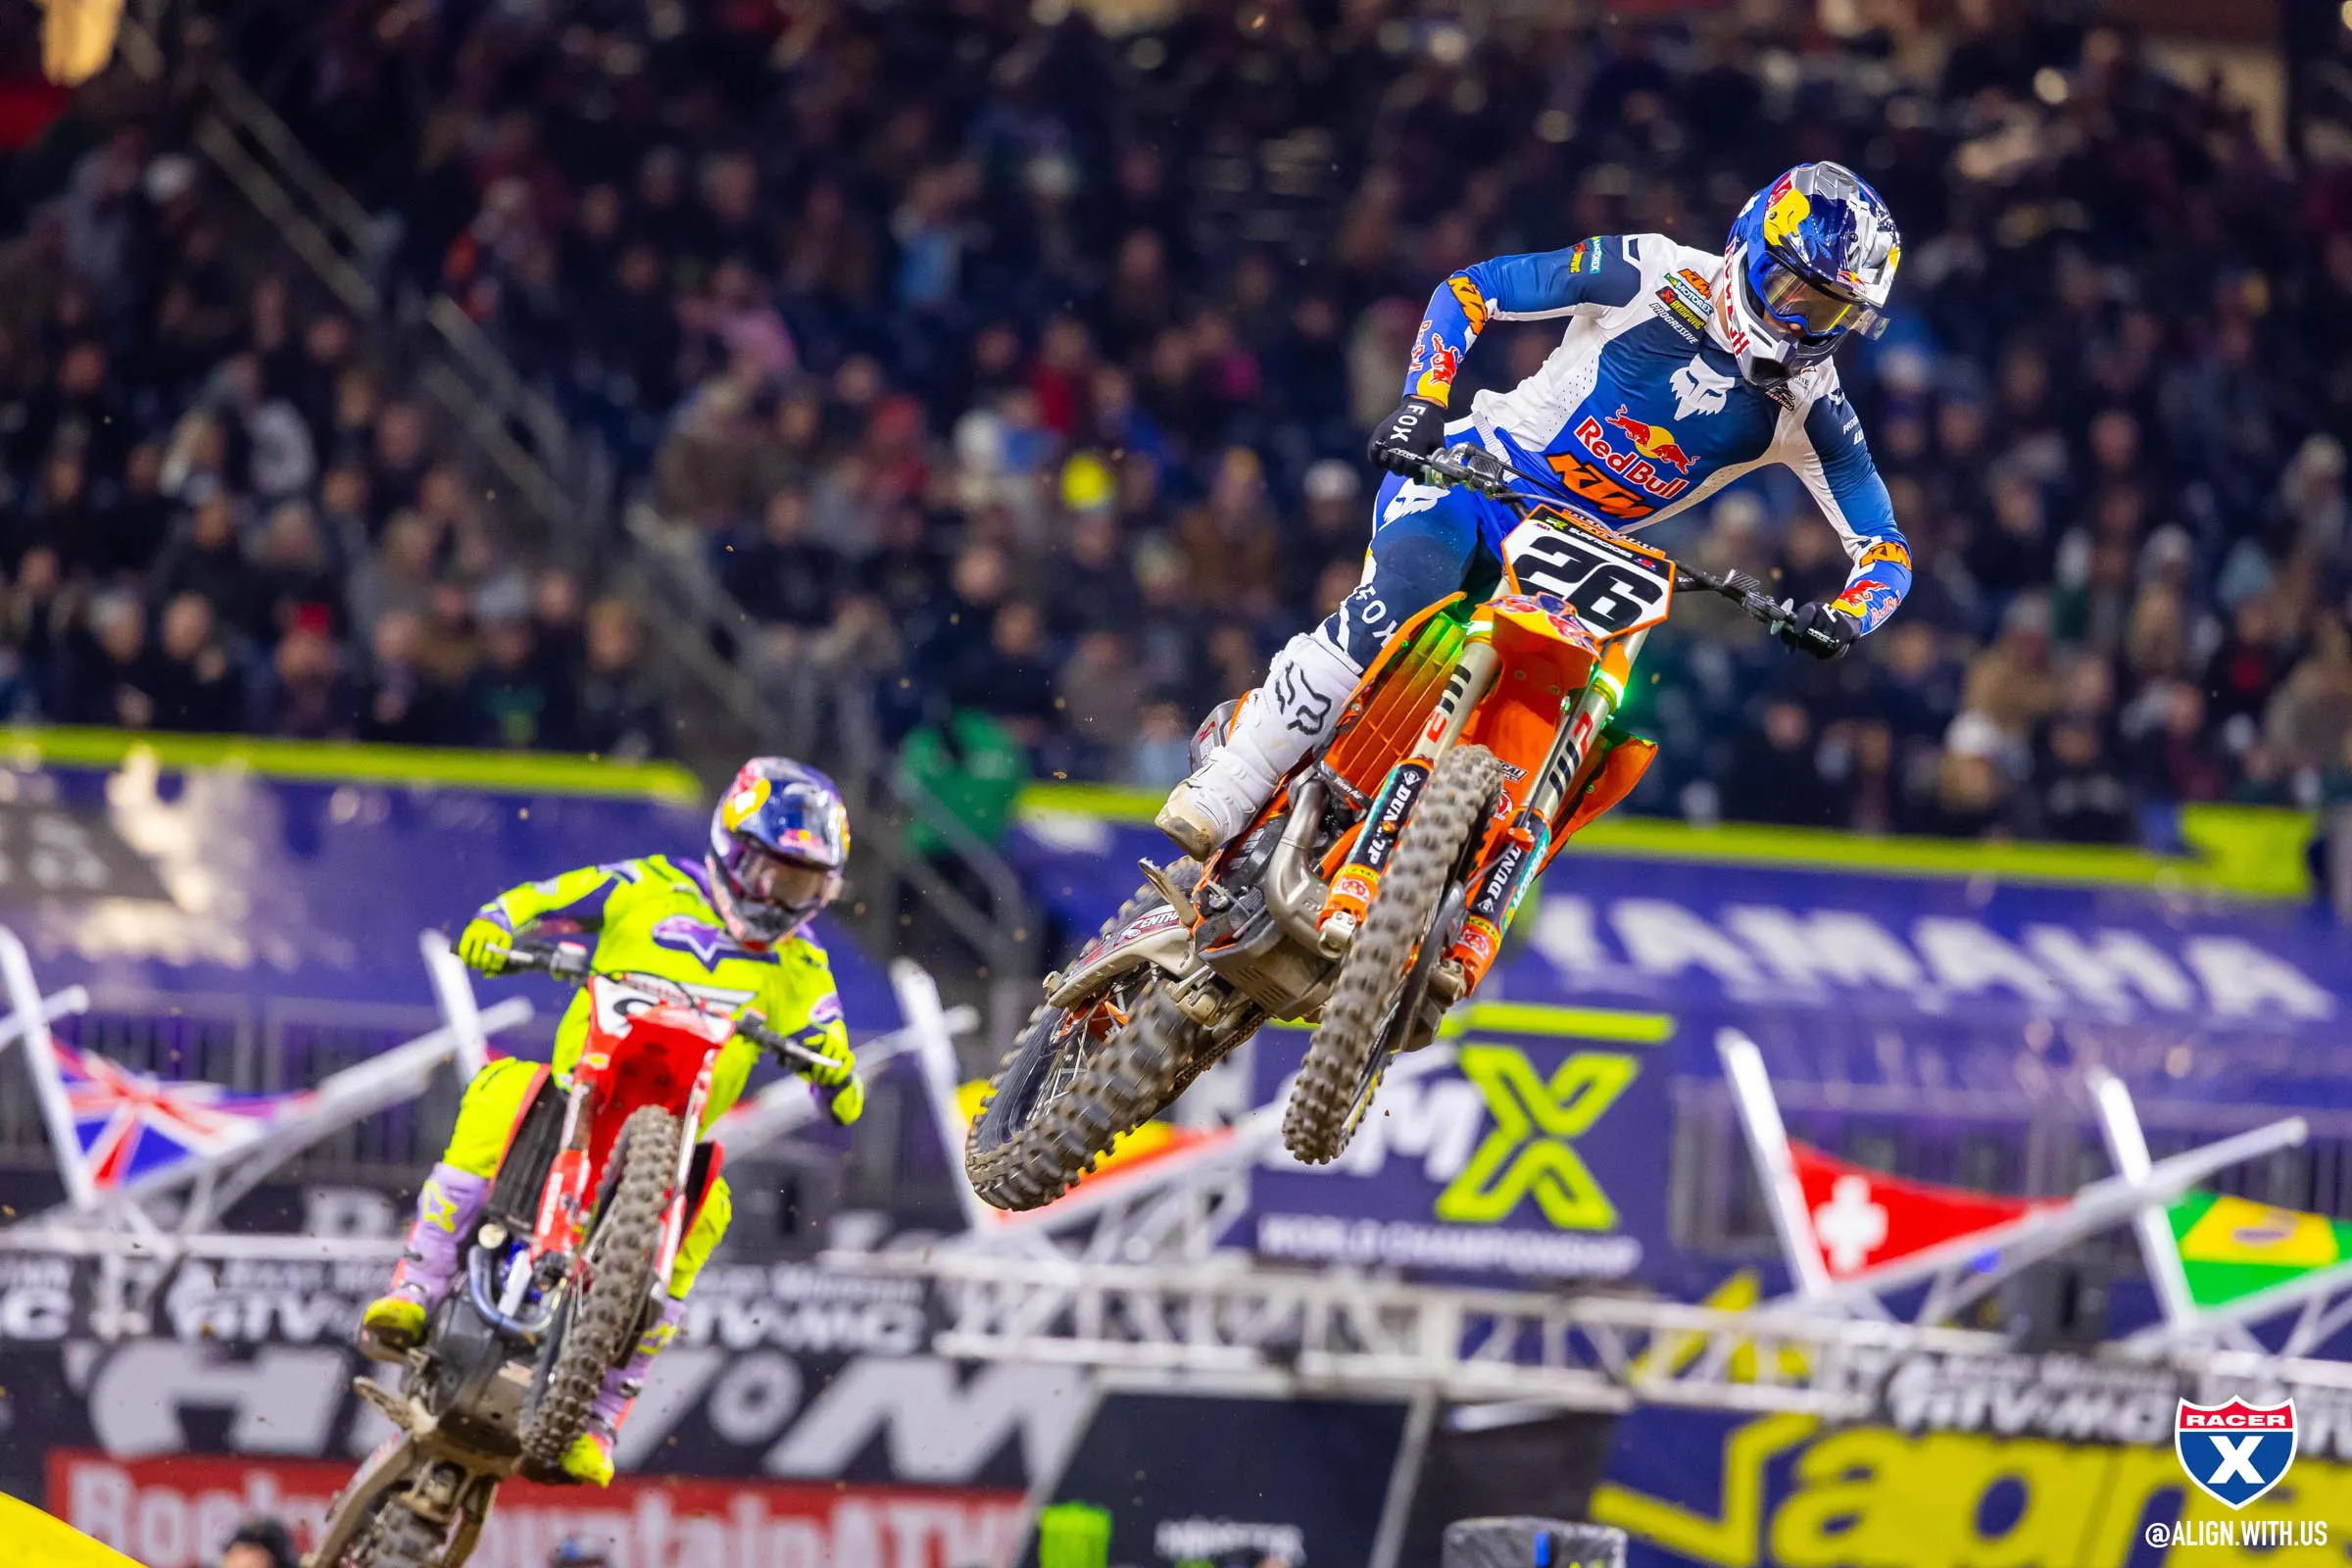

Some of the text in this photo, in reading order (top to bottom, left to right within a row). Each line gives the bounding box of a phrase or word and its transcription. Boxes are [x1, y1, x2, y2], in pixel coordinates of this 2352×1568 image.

[1675, 281, 1713, 316] MOTOREX
[1648, 302, 1698, 345] PROGRESSIVE
[1390, 404, 1427, 443] FOX
[1544, 452, 1655, 519] KTM
[1513, 536, 1664, 634] 26
